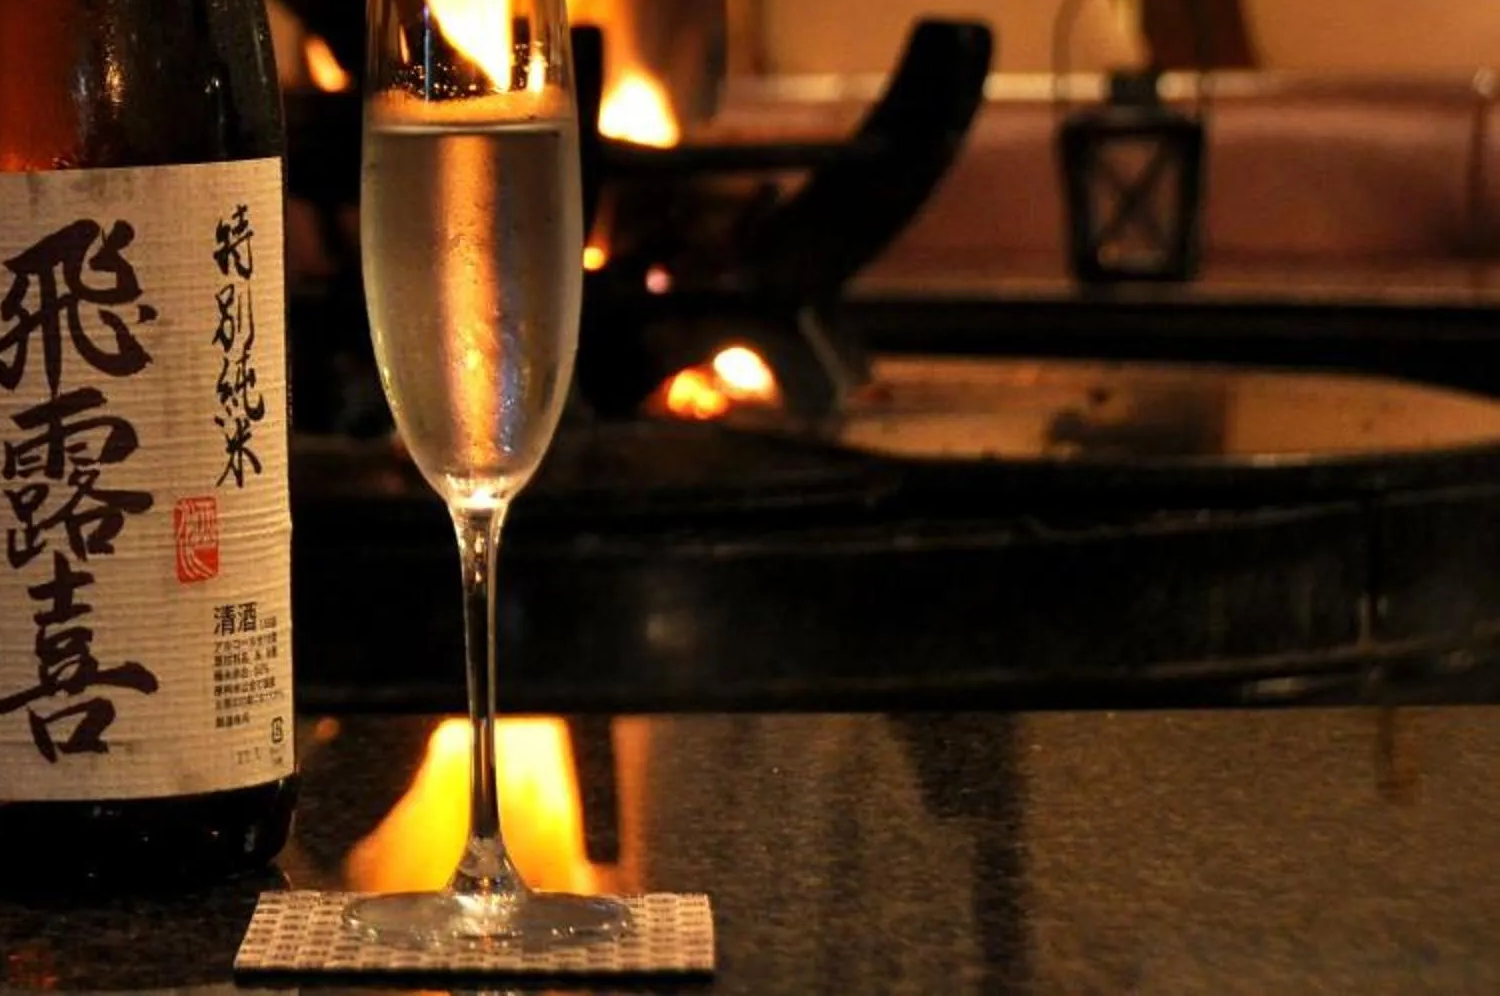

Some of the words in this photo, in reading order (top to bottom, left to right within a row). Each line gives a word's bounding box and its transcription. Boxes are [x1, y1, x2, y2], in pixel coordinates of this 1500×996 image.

[212, 204, 265, 489] 特別純米
[214, 602, 258, 636] 清酒
